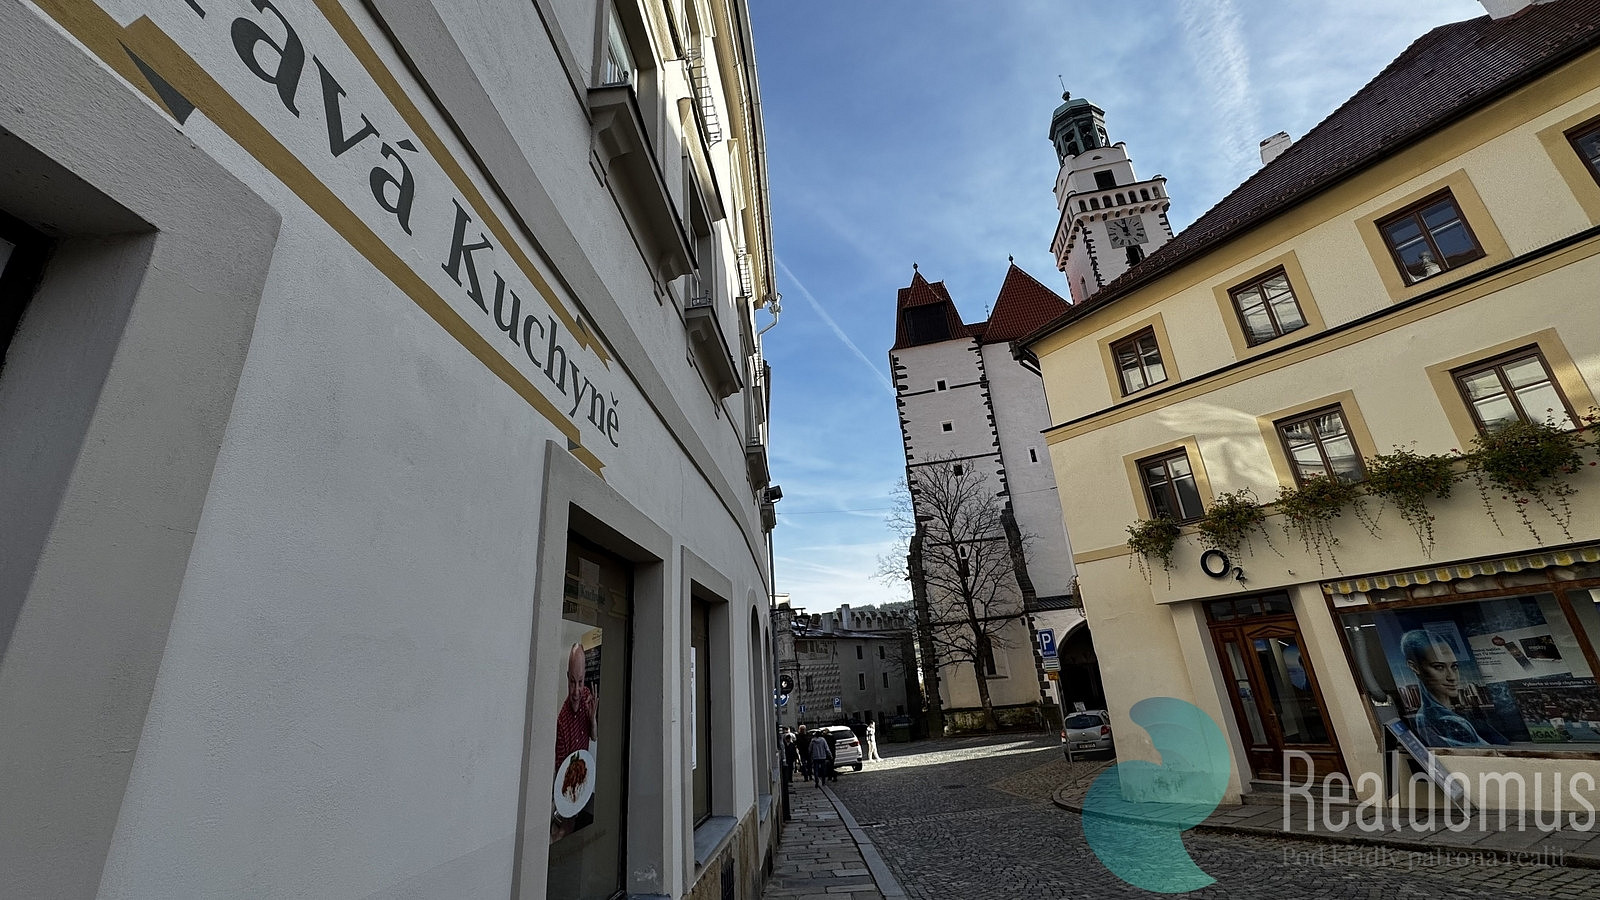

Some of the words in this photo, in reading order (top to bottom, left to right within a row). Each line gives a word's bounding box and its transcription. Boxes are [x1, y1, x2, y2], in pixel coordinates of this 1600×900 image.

[185, 0, 419, 236] avá
[442, 198, 620, 448] Kuchyně
[1042, 633, 1052, 650] P
